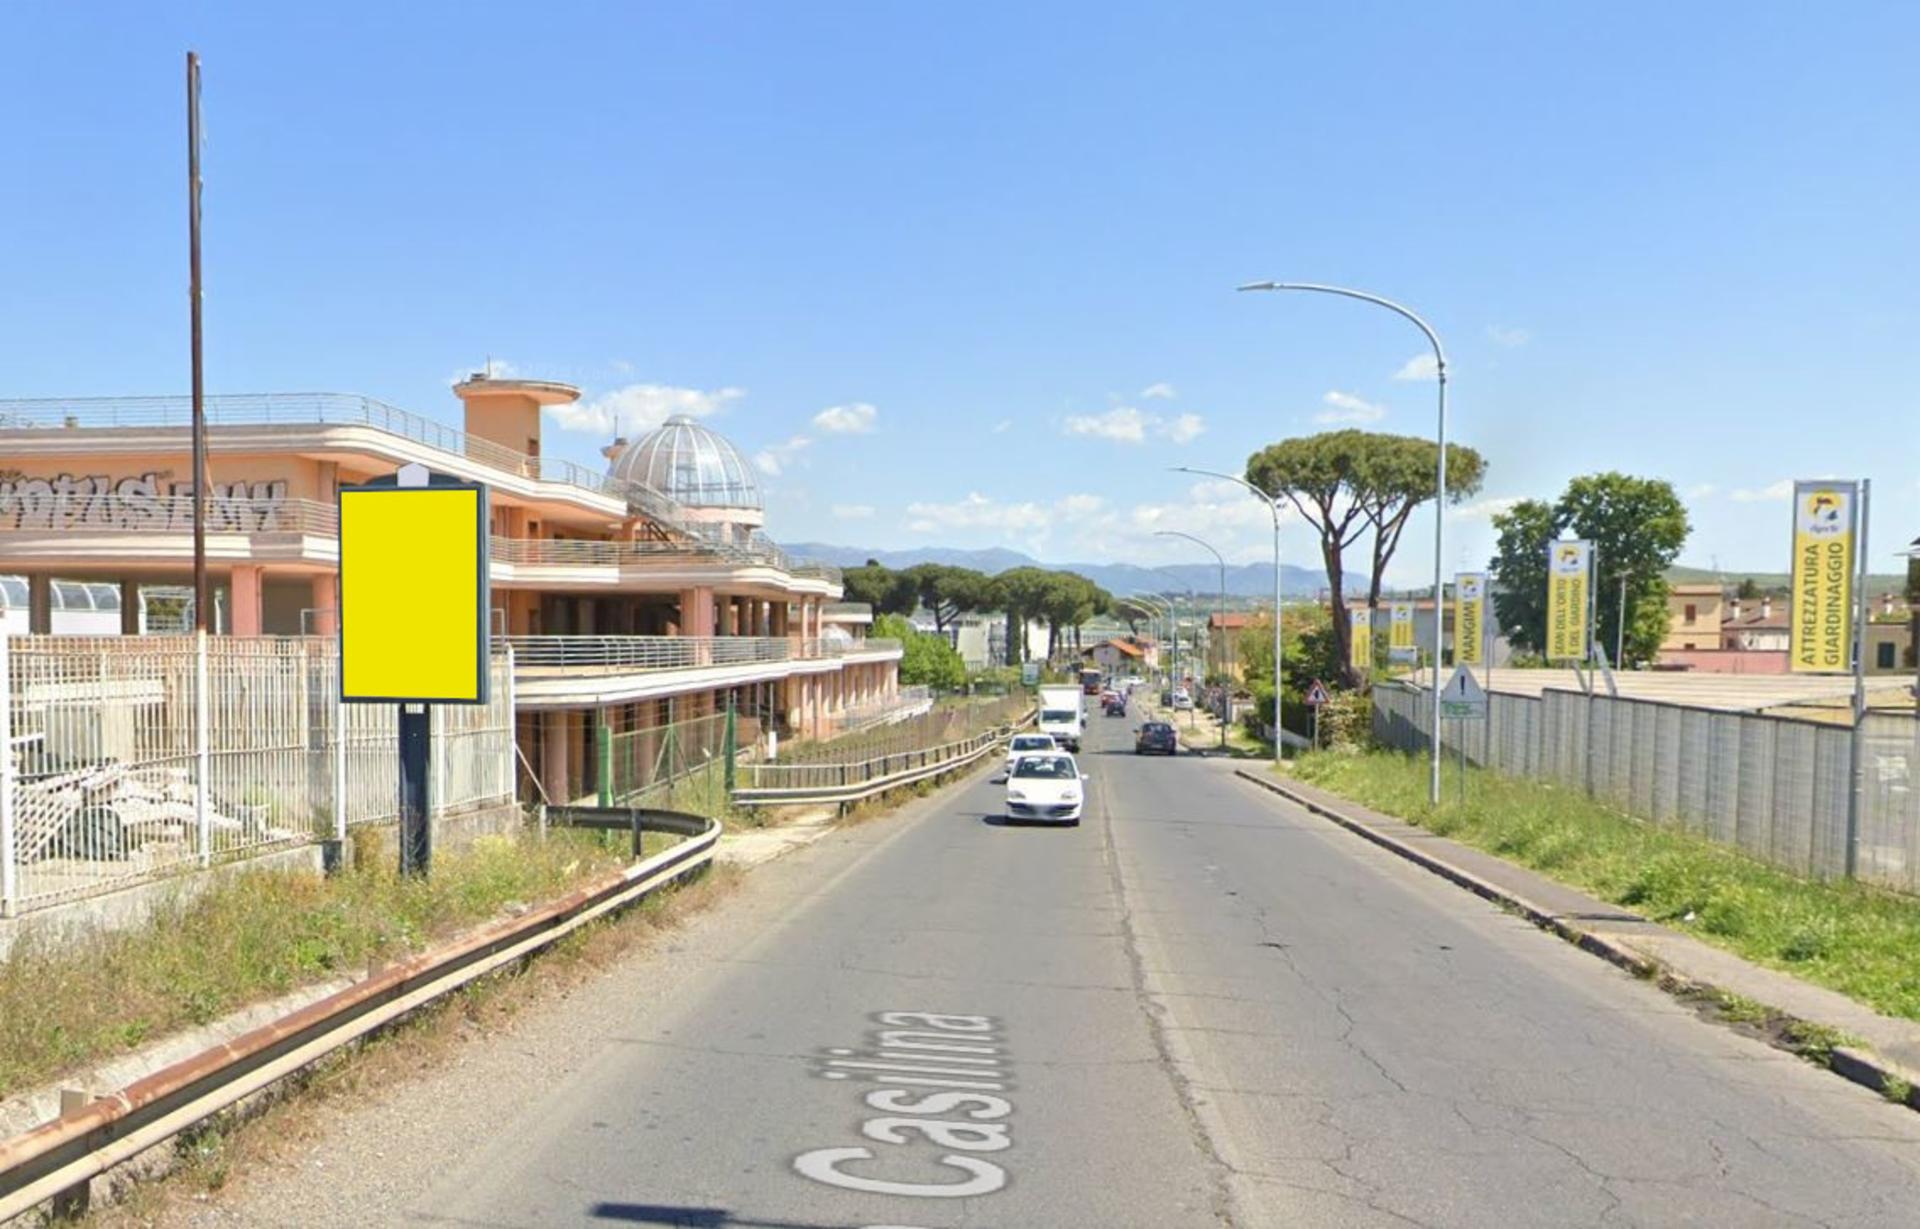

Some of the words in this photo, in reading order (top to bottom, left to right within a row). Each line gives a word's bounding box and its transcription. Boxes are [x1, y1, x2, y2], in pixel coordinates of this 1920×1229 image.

[1462, 602, 1476, 661] MANGIMI
[1801, 543, 1820, 665] ATTREZZATURA
[1825, 542, 1844, 665] GIARDINAGGIO
